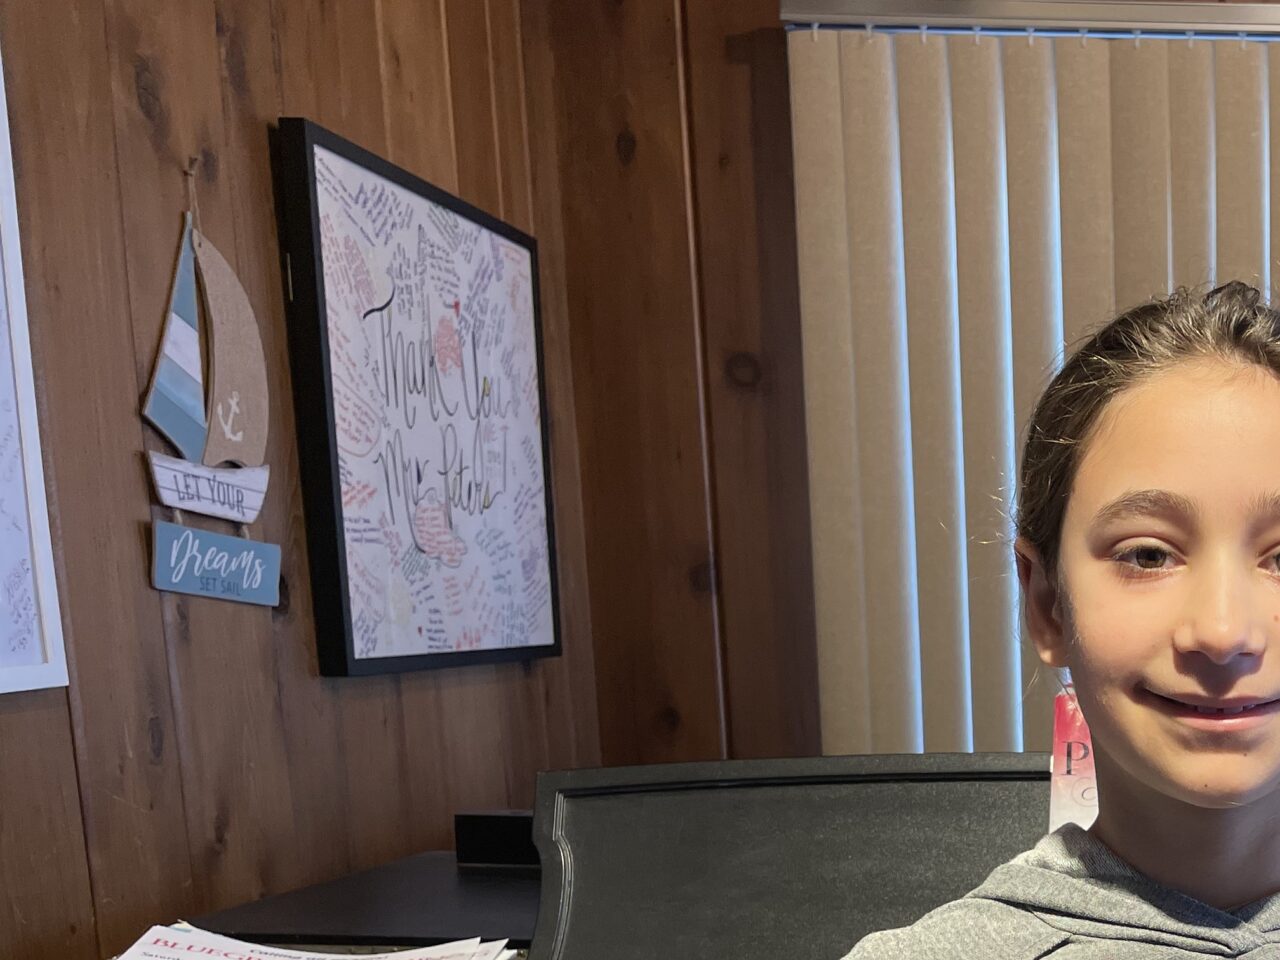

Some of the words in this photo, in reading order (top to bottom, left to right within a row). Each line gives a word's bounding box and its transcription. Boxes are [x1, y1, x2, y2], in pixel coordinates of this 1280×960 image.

[173, 473, 202, 502] LET
[207, 475, 246, 517] YOUR
[170, 530, 266, 590] Dreams
[199, 576, 217, 591] SET
[220, 580, 241, 596] SAIL
